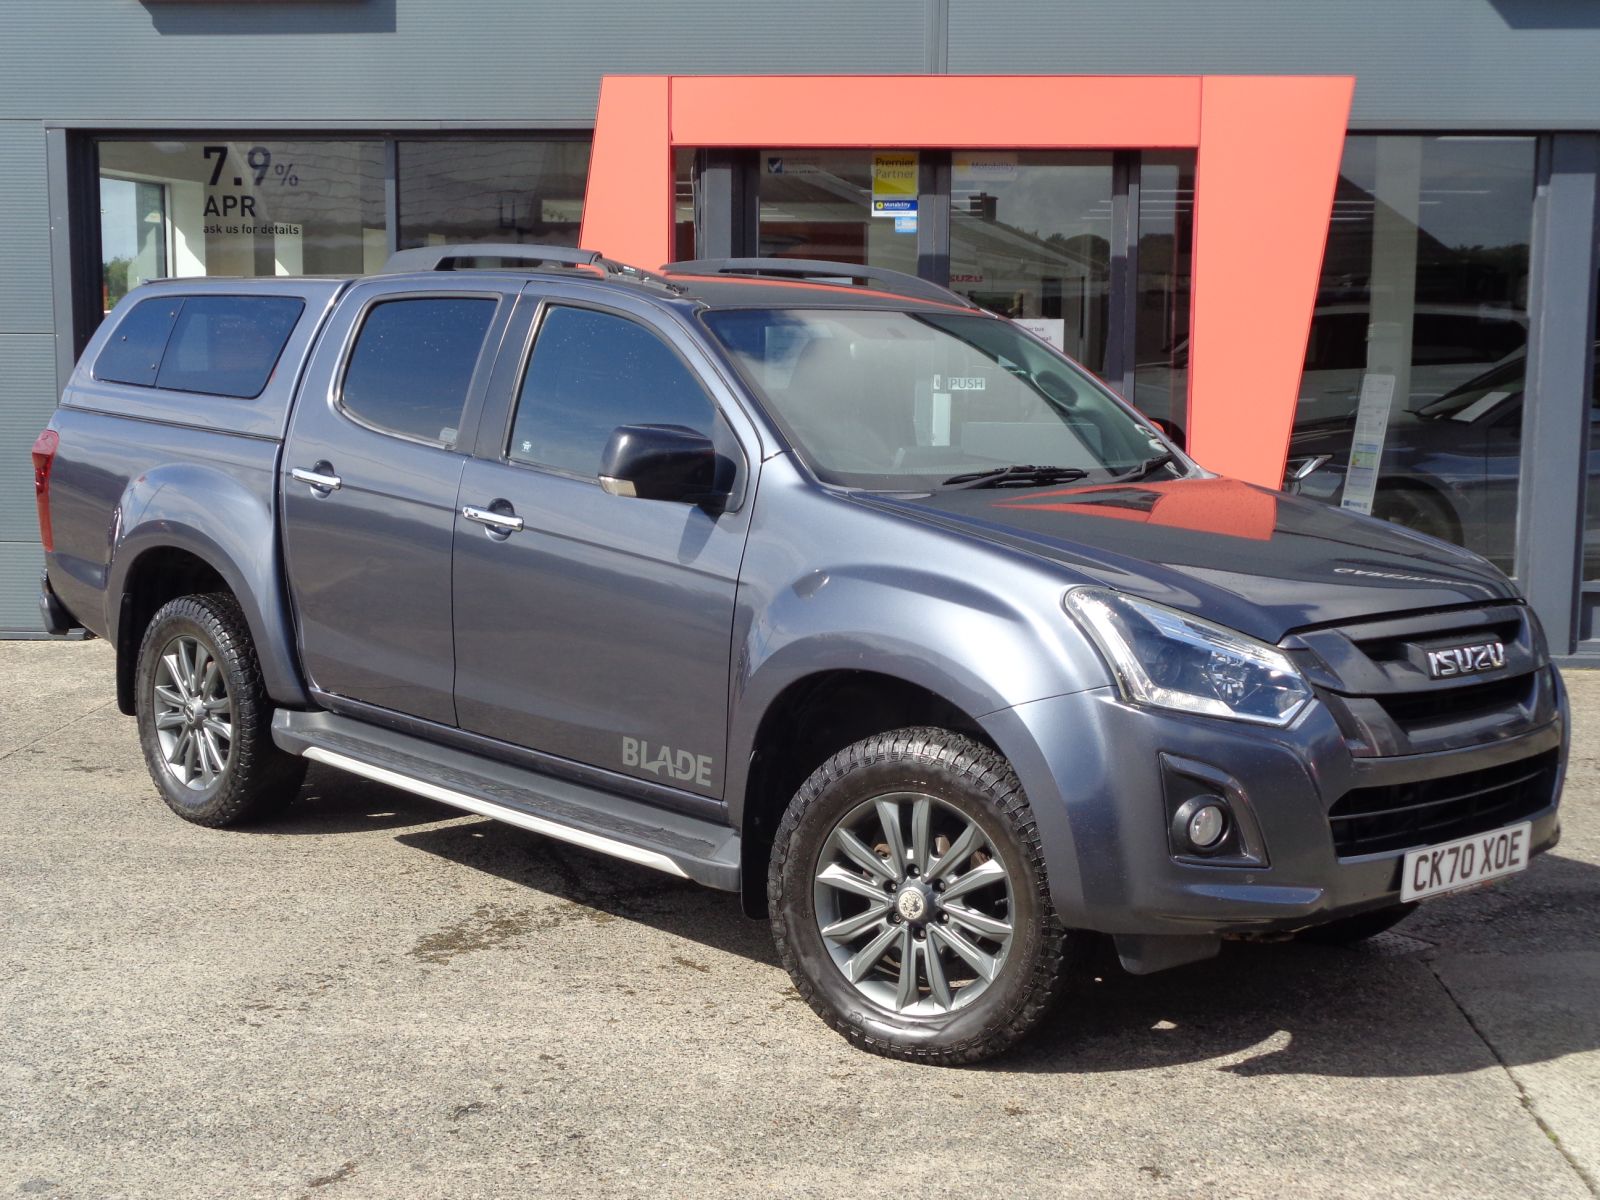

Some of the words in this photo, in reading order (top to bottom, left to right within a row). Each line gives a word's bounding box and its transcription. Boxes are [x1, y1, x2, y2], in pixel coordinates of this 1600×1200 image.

[876, 156, 915, 167] Premier
[971, 160, 1016, 173] Motability
[876, 168, 915, 179] Partner
[203, 195, 256, 217] APR
[883, 201, 911, 210] Motability
[203, 223, 222, 234] ask
[226, 225, 239, 234] us
[242, 223, 257, 235] for
[261, 223, 299, 236] details
[949, 273, 984, 283] SUZU
[950, 378, 984, 390] PUSH
[1428, 642, 1505, 677] ISUZU
[622, 736, 713, 788] BLADE
[1413, 842, 1474, 893] CK70
[1480, 829, 1523, 875] XOE
